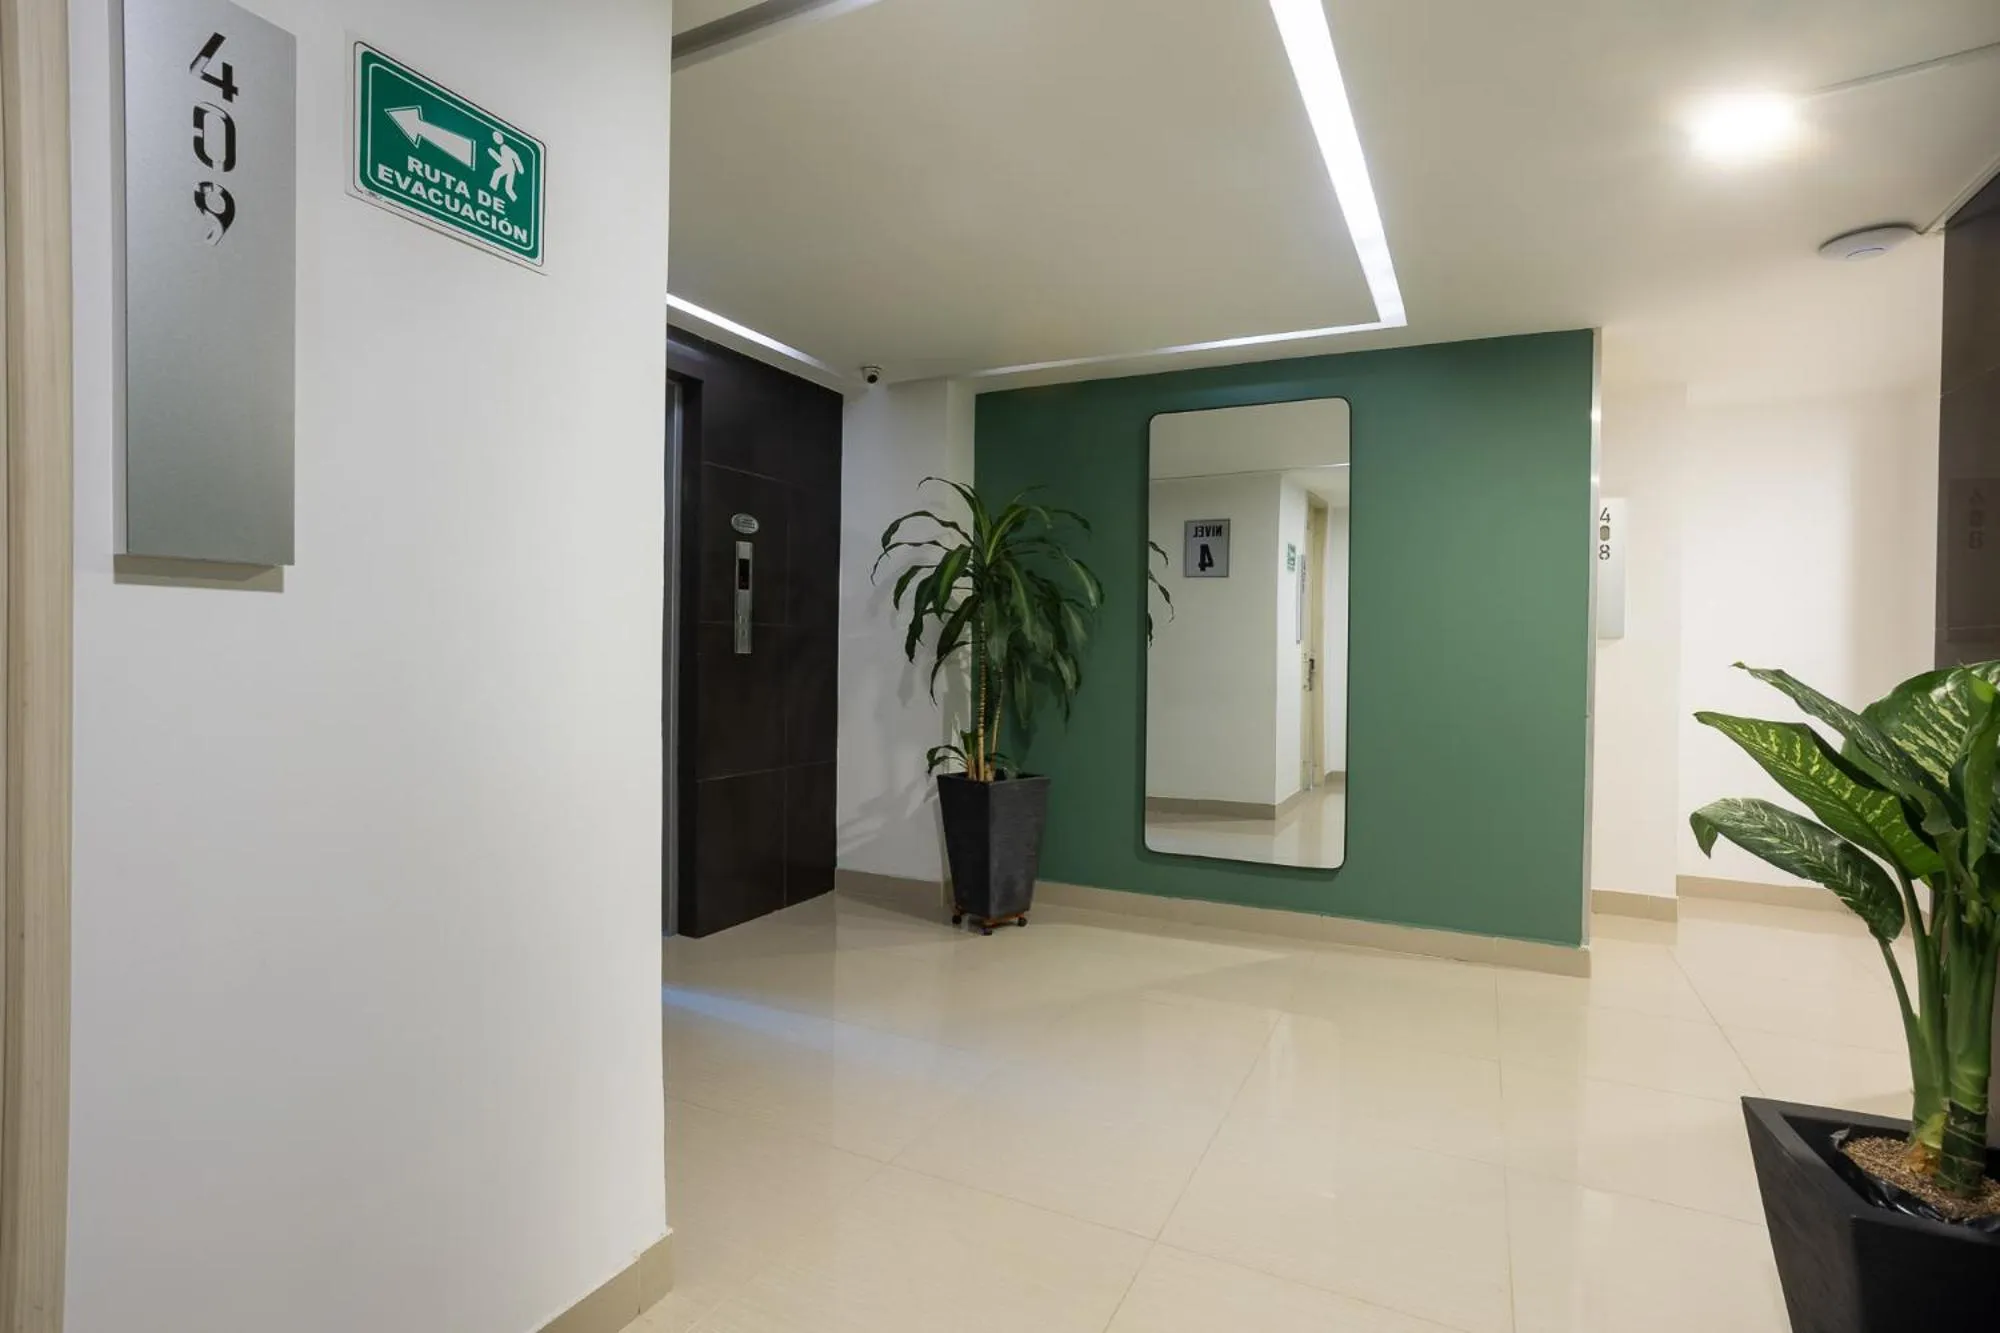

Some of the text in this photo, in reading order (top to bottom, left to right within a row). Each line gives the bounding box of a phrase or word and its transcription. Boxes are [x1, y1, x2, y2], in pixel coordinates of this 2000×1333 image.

[189, 32, 239, 247] 409
[377, 163, 529, 244] EVACUACIÓN
[407, 155, 506, 215] RUTA DE
[1599, 507, 1611, 560] 408
